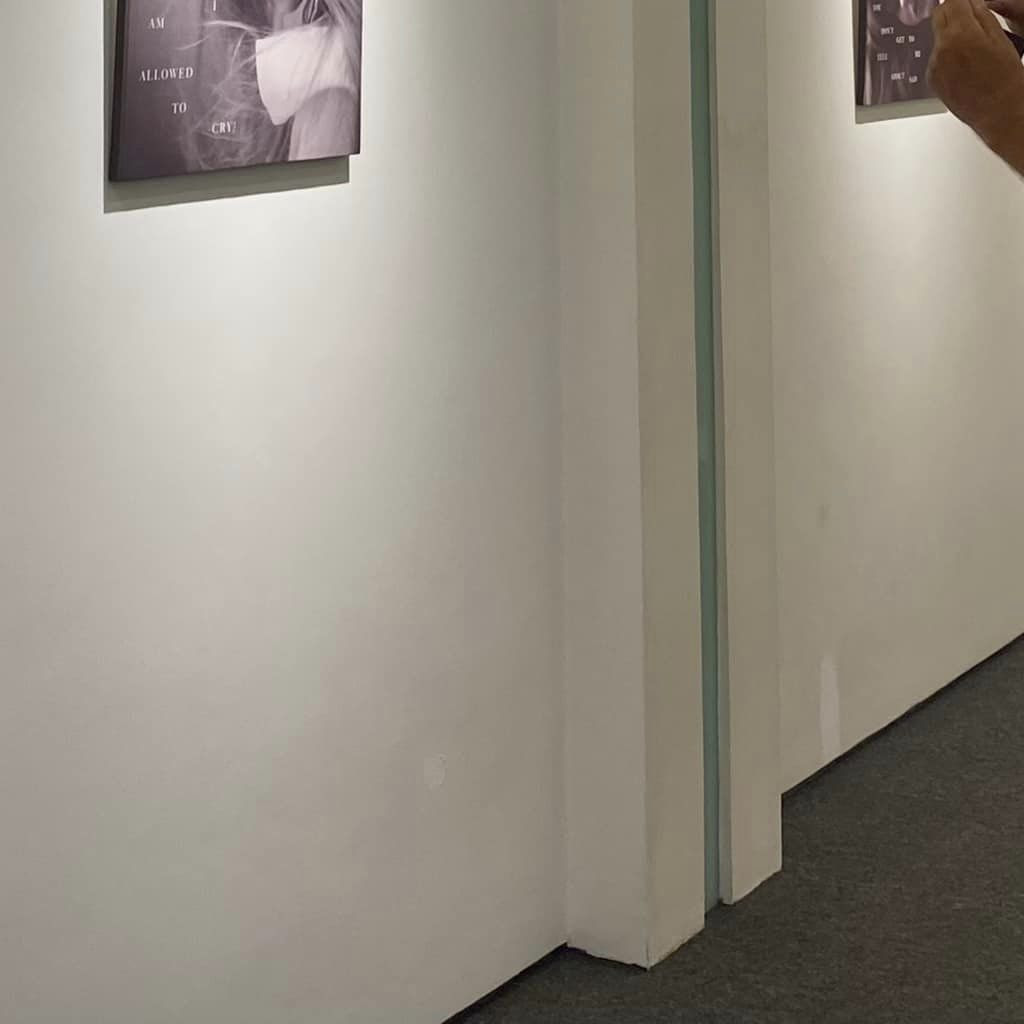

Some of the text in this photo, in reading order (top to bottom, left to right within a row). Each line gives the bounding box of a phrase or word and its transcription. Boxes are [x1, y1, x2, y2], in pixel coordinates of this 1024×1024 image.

[149, 17, 165, 30] AM
[139, 67, 194, 81] ALLOWED
[171, 102, 187, 114] TO
